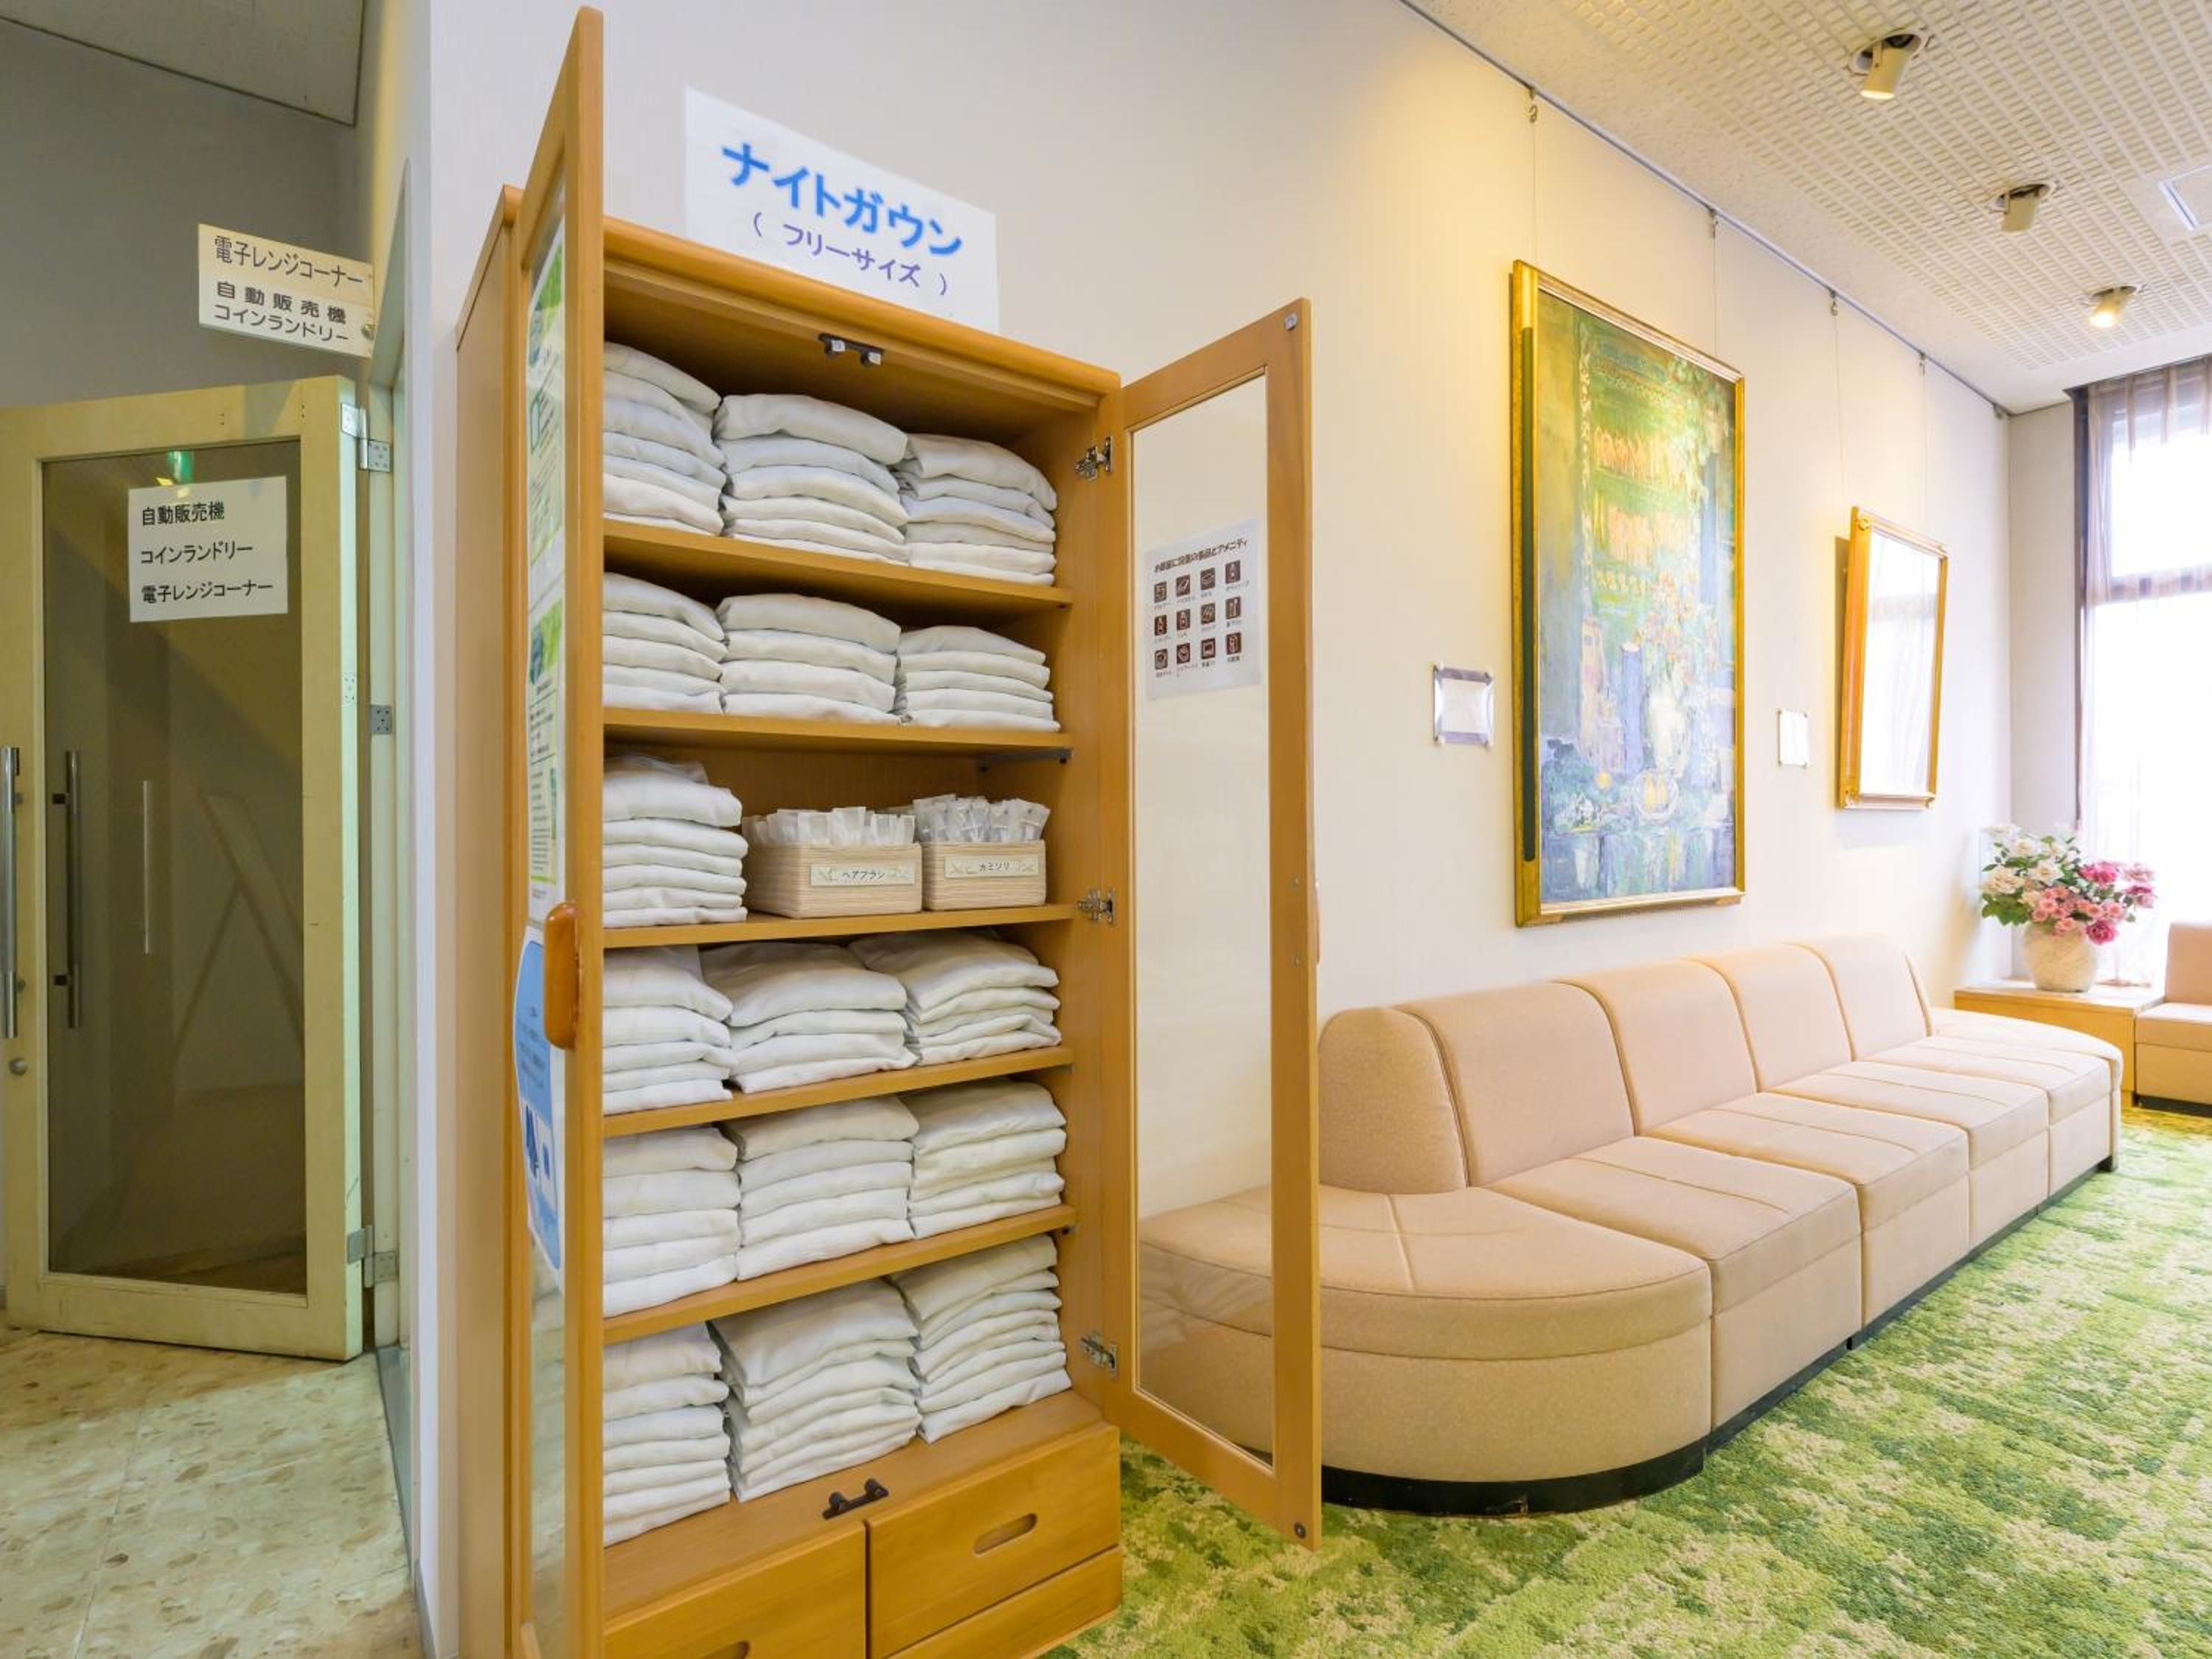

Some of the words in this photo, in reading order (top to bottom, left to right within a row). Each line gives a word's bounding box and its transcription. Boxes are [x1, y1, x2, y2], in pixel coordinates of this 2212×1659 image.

[721, 142, 963, 257] ナイトガウン
[214, 235, 363, 287] 電子レンジコーナー
[217, 281, 347, 324] 自動販売機
[214, 304, 349, 341] コインランドリー
[142, 501, 225, 526] 自動販売機
[141, 540, 253, 565] コインランドリー
[141, 580, 274, 604] 電子レンジコーナー
